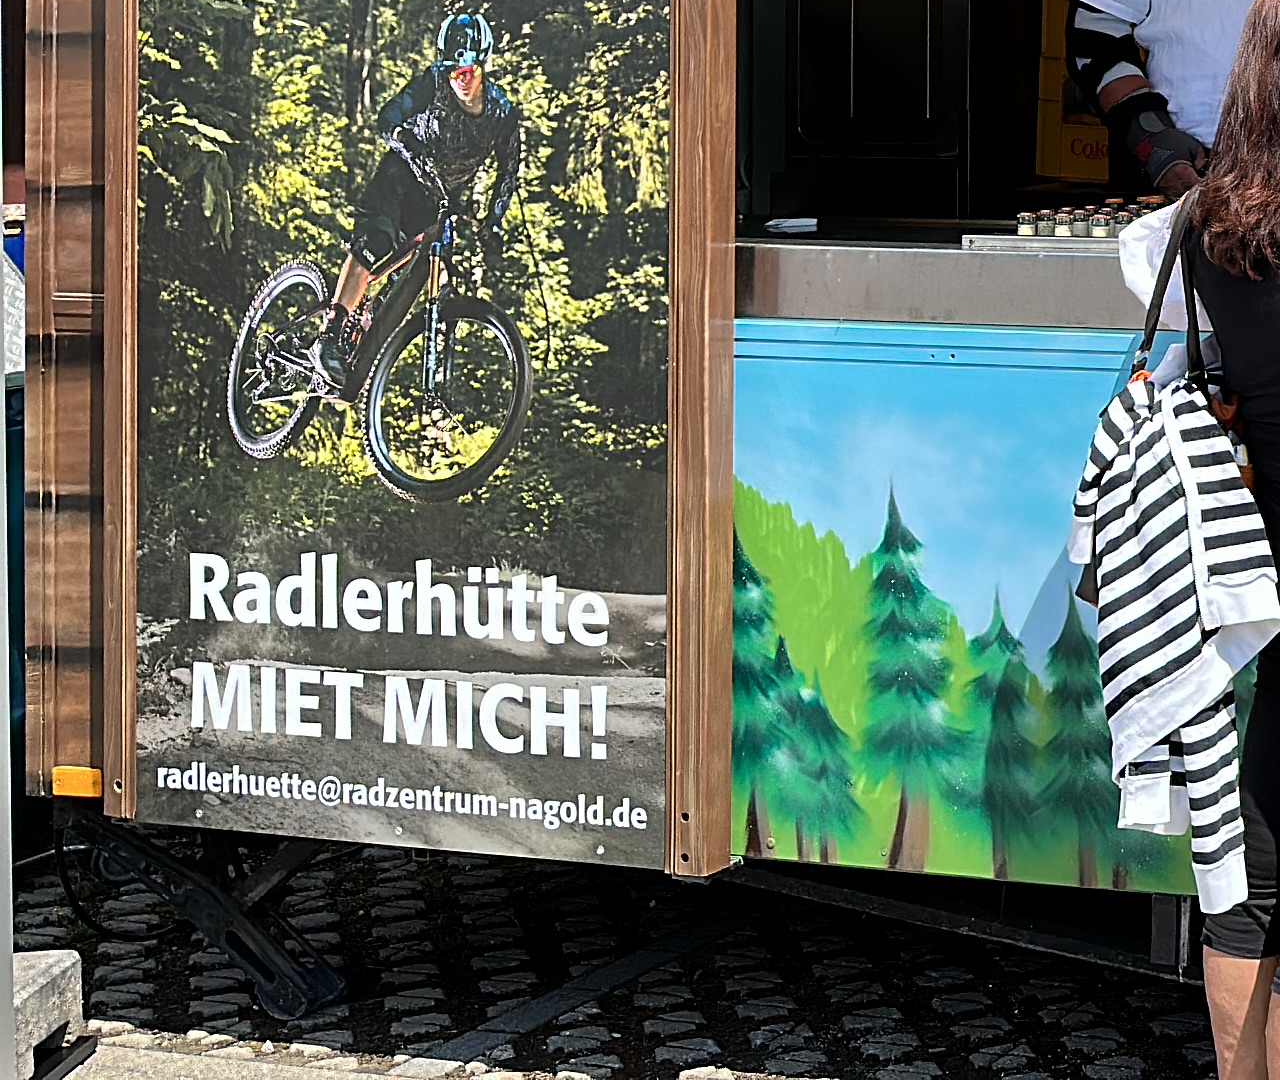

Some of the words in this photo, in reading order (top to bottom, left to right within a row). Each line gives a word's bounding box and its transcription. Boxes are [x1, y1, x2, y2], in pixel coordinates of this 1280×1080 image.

[1071, 138, 1108, 159] Cok
[188, 551, 610, 647] Radlerhütte
[190, 661, 364, 740] MIET
[382, 675, 608, 760] MICH!
[157, 761, 648, 830] radlerhuette@radzentrum-nagold.de
